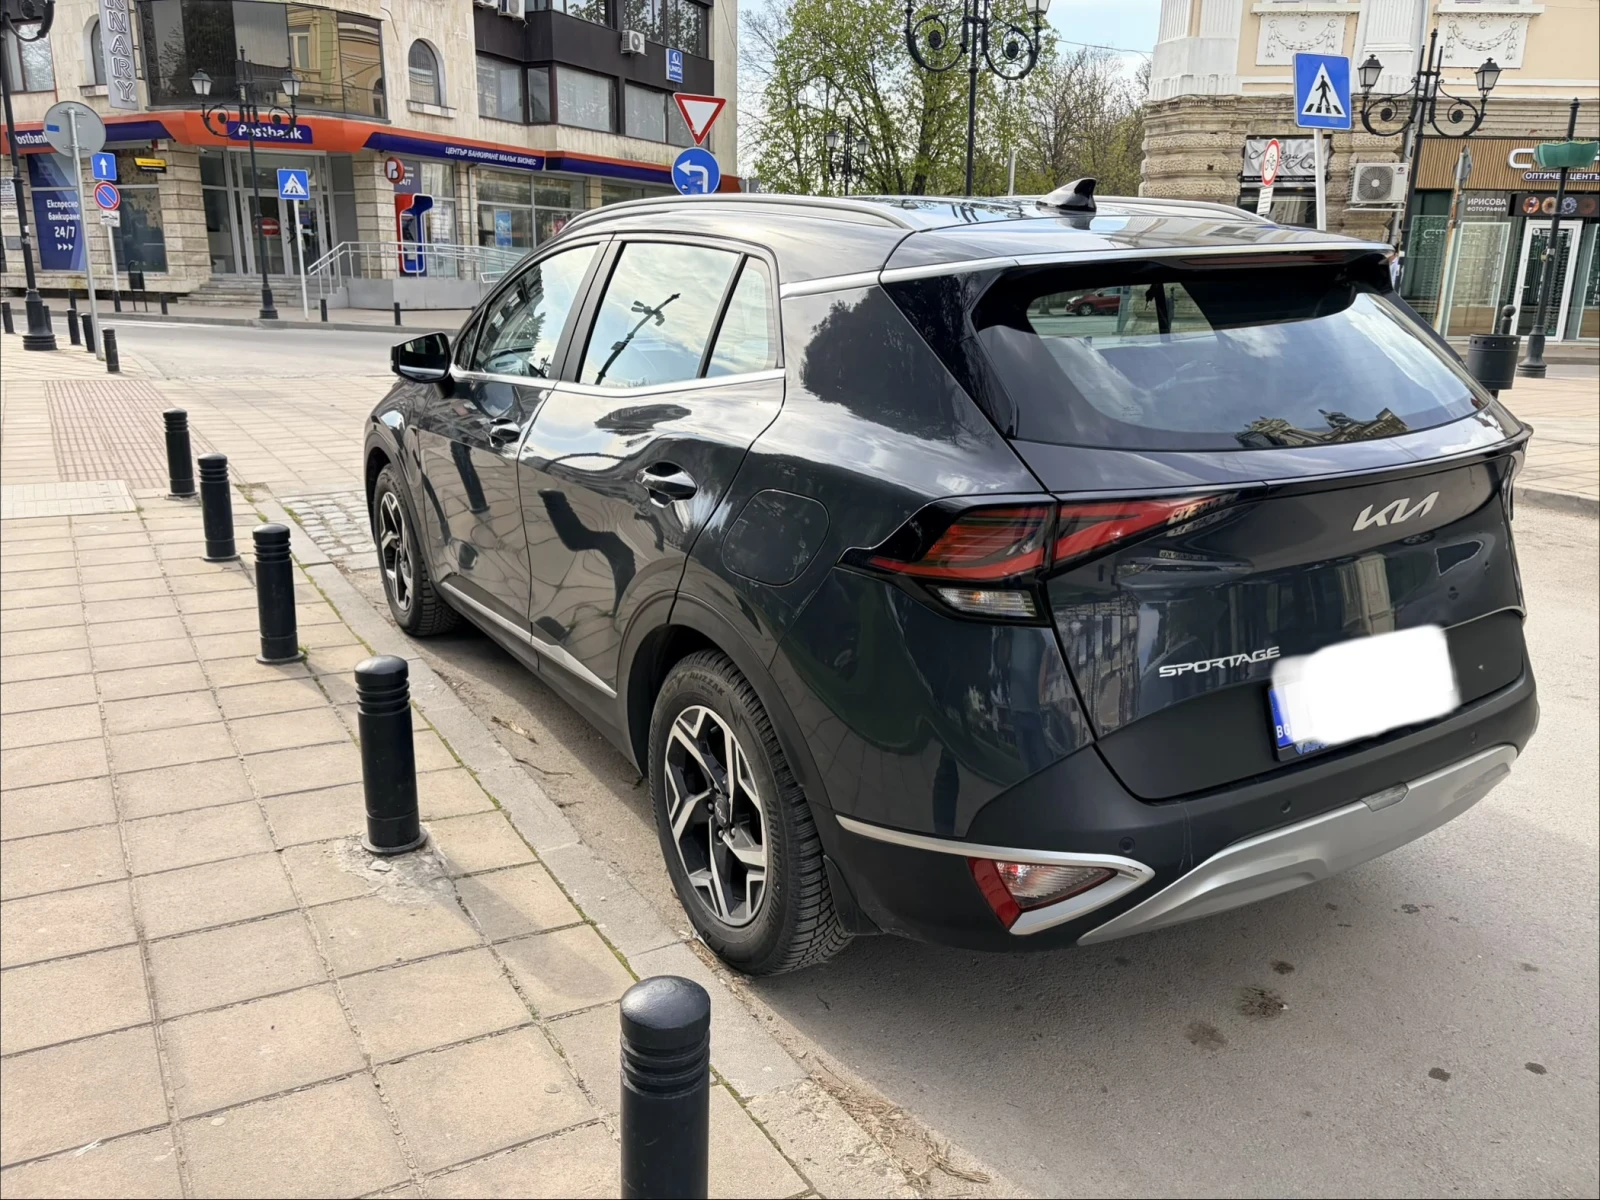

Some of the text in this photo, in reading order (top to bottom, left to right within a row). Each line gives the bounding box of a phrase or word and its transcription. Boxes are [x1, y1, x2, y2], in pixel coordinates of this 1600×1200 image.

[15, 132, 48, 145] ostbank
[445, 146, 537, 166] ЦЕНТЪР БАНКИРАНЕ МАЛЪК БИЗНЕС
[1525, 172, 1567, 180] ОПТИЧЕ
[46, 199, 79, 210] Експресно
[1467, 198, 1507, 206] ИРИСОВА
[48, 211, 80, 223] банкиране
[54, 225, 75, 239] 24/7
[1352, 491, 1440, 531] KIA
[1158, 646, 1281, 678] SPORTAGE
[689, 672, 726, 696] BLIZZAK
[1275, 723, 1290, 739] BG
